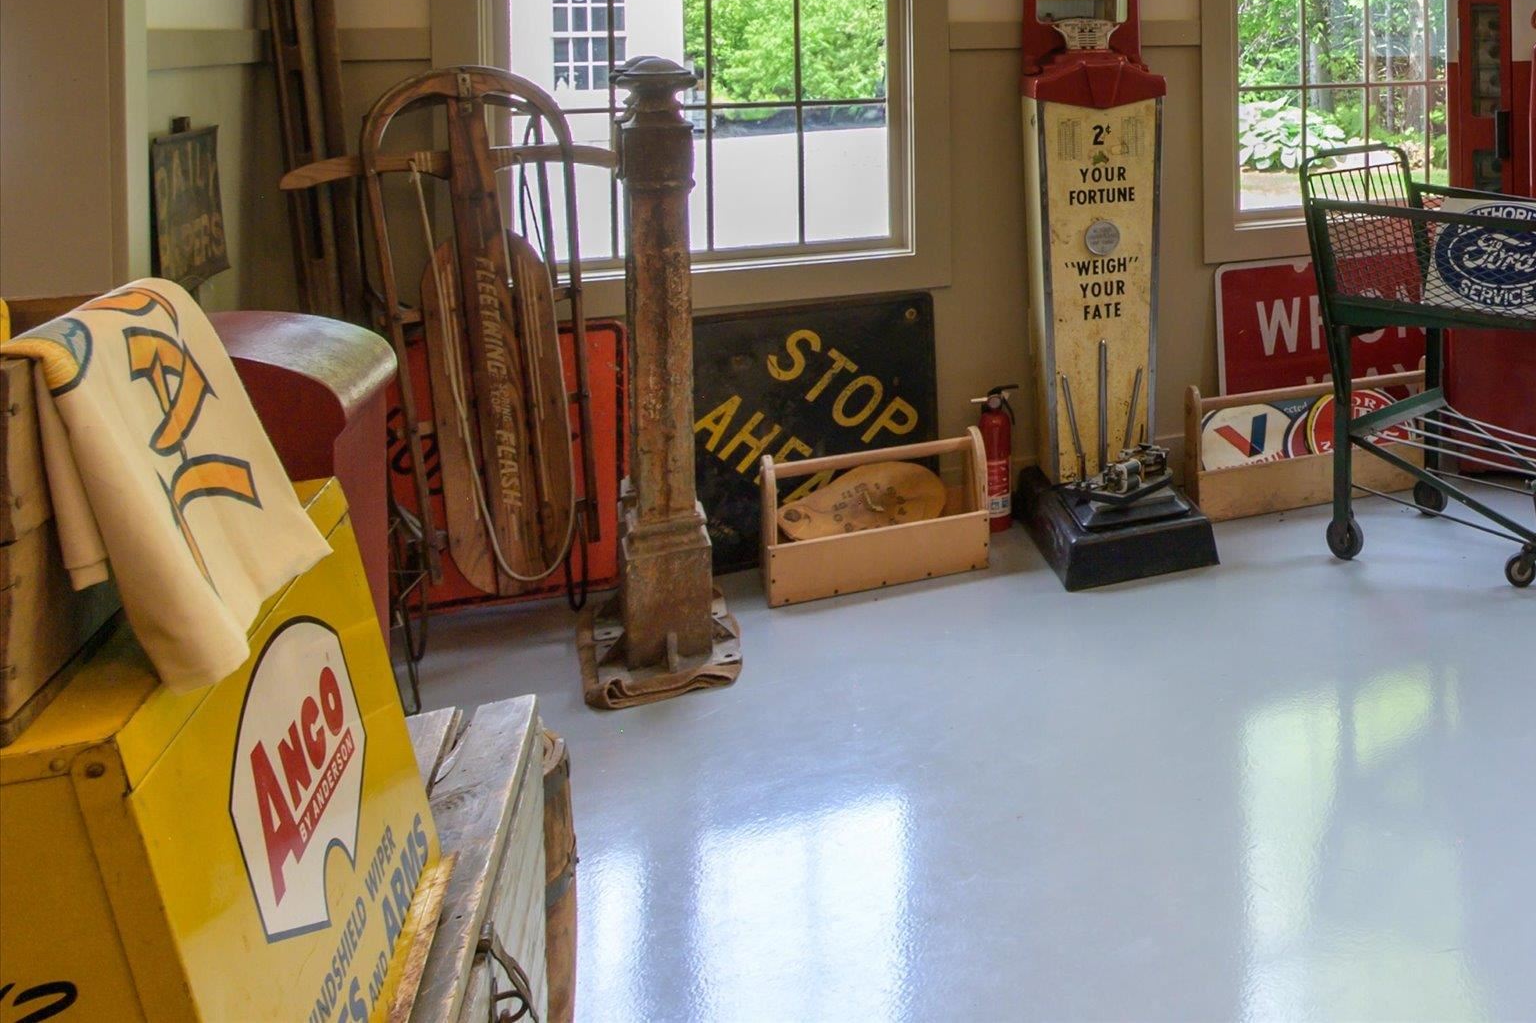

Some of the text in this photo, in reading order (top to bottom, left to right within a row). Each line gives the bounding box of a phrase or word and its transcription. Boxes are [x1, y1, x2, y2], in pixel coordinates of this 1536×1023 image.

[1069, 187, 1135, 206] FORTUNE
[1080, 166, 1126, 183] YOUR
[475, 255, 508, 379] FLEETWING
[1080, 280, 1125, 299] YOUR
[1083, 302, 1121, 321] FATE
[1459, 279, 1534, 305] SERVICE
[767, 329, 919, 444] STOP
[495, 429, 523, 507] FLASH
[249, 666, 344, 907] ANCO
[300, 734, 355, 843] BY ANDERSON
[309, 896, 367, 1023] INDSHIELD
[365, 824, 396, 903] WIPER
[368, 812, 430, 1010] AND ARMS
